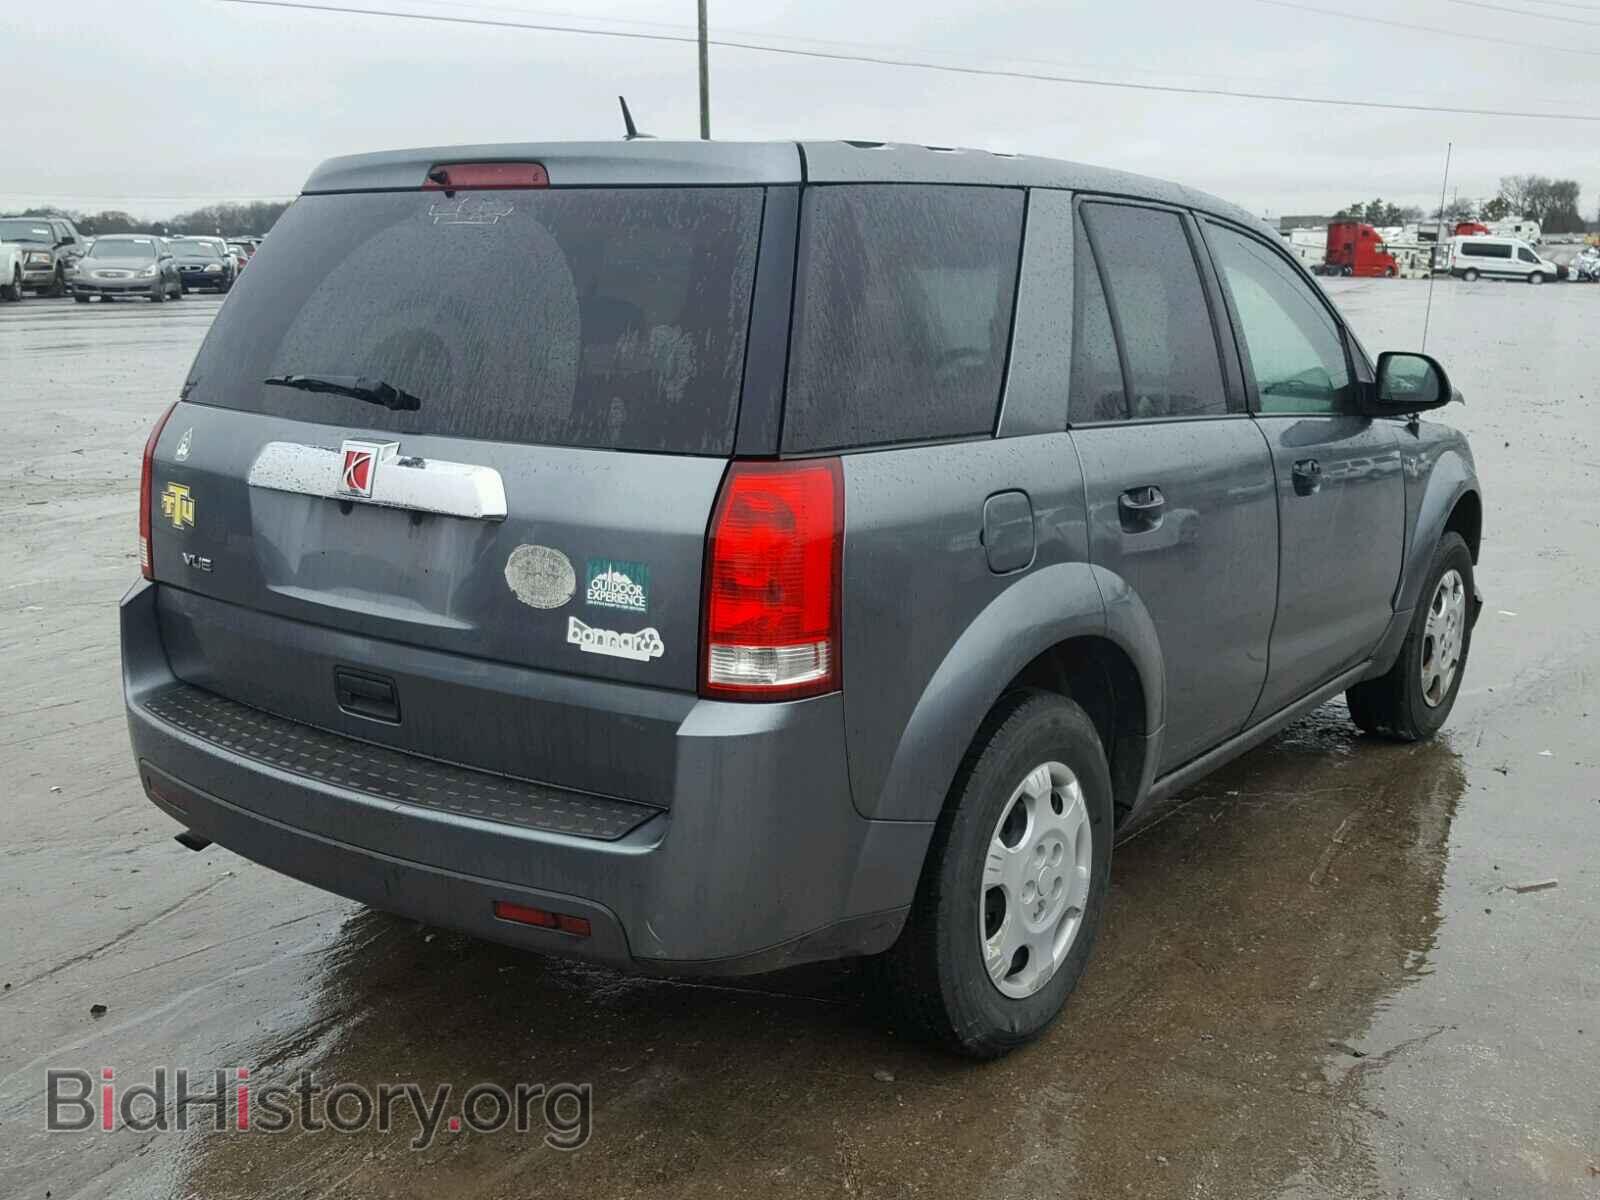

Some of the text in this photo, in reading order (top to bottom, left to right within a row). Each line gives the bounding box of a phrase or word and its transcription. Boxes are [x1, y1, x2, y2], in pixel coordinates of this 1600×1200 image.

[182, 552, 213, 572] VUE
[591, 578, 643, 596] OUTDOOR
[586, 588, 646, 607] EXPERIENCE
